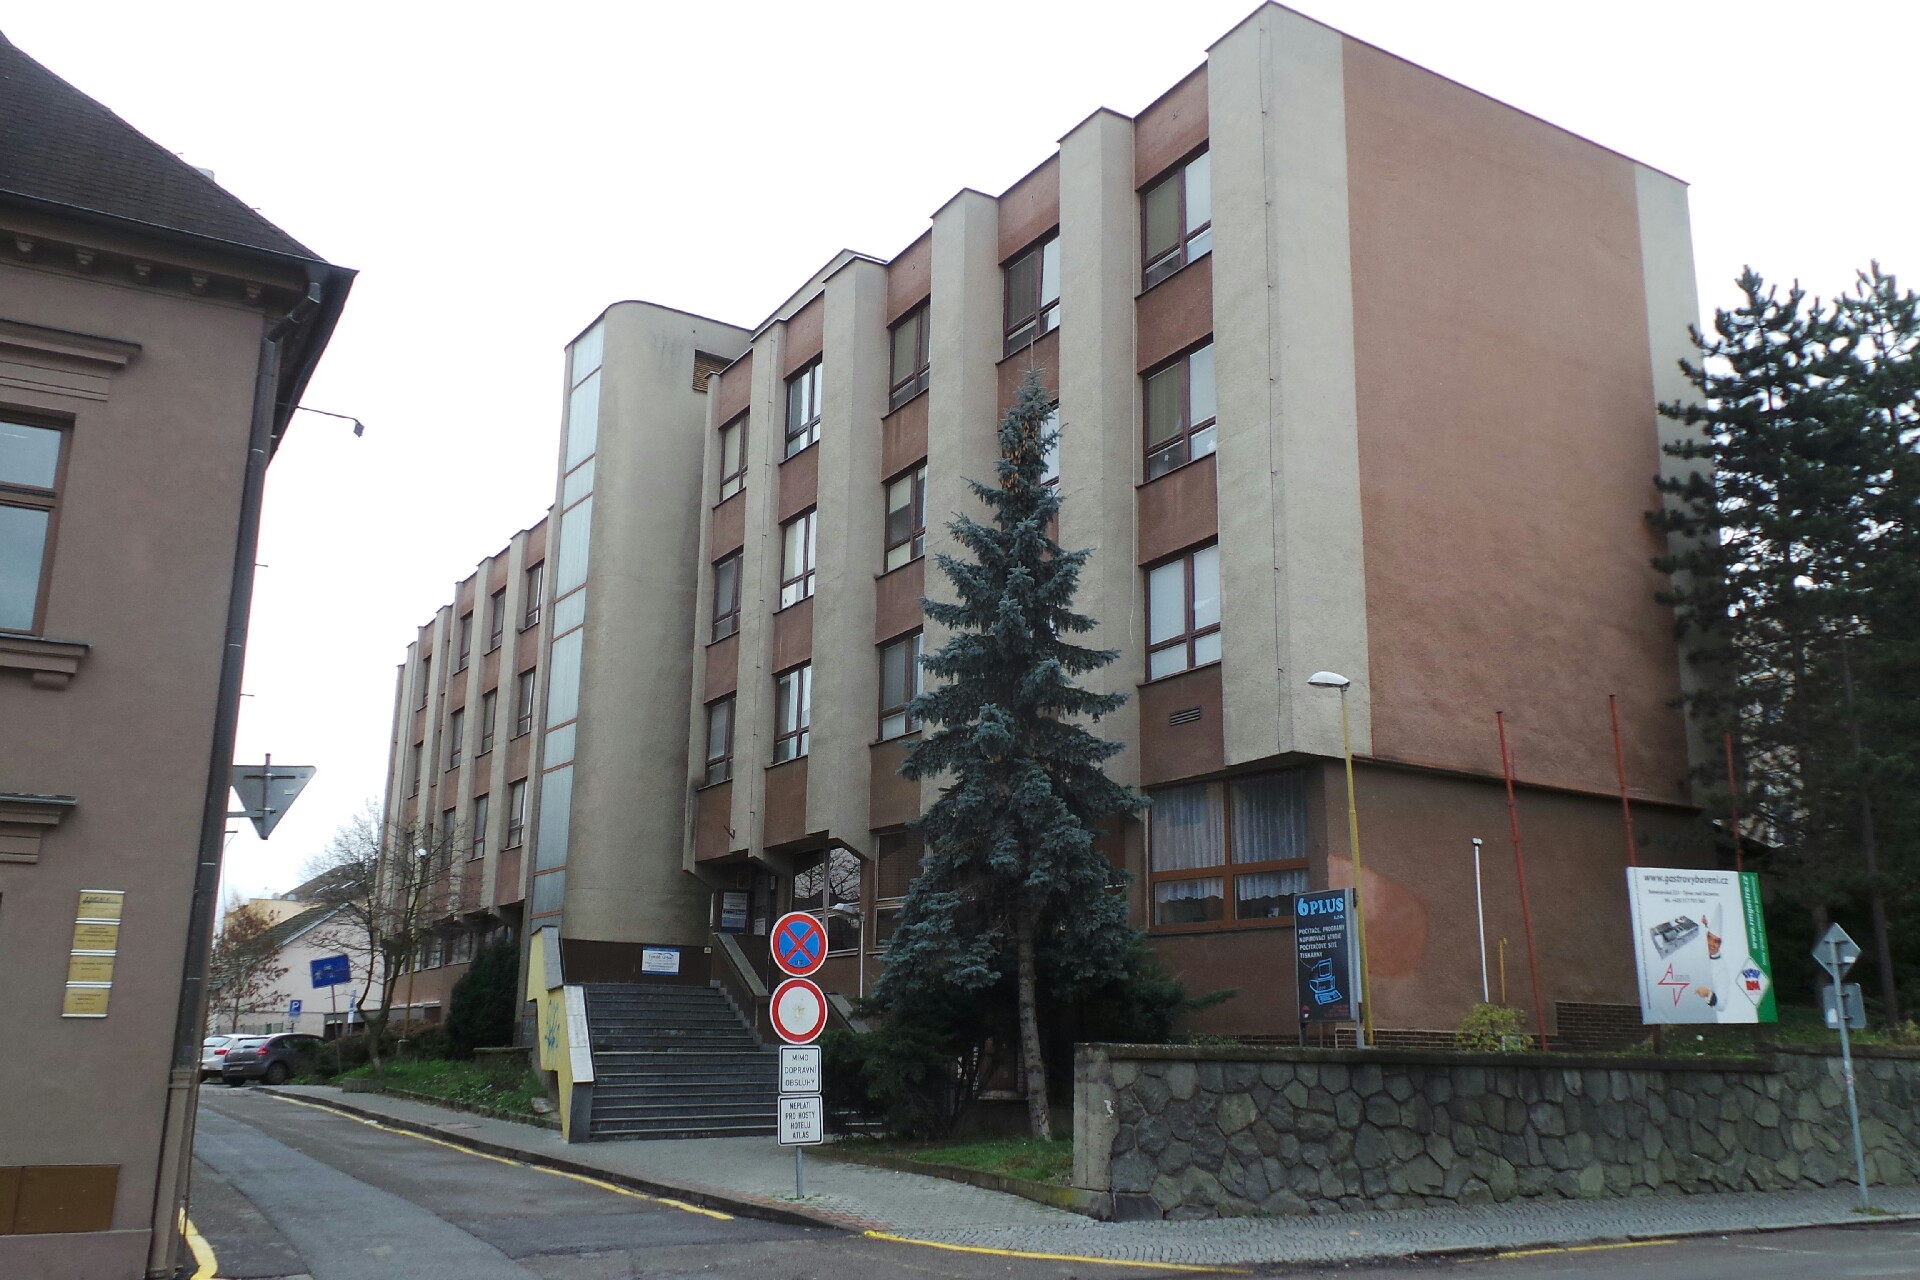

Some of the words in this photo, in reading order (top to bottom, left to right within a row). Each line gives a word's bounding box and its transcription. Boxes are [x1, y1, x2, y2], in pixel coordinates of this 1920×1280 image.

[784, 1064, 817, 1074] DOPRAVNÍ
[785, 1079, 815, 1087] OBSLUHY
[785, 1112, 796, 1120] PRO
[790, 1121, 811, 1130] HOTELU
[792, 1131, 810, 1139] ATLAS
